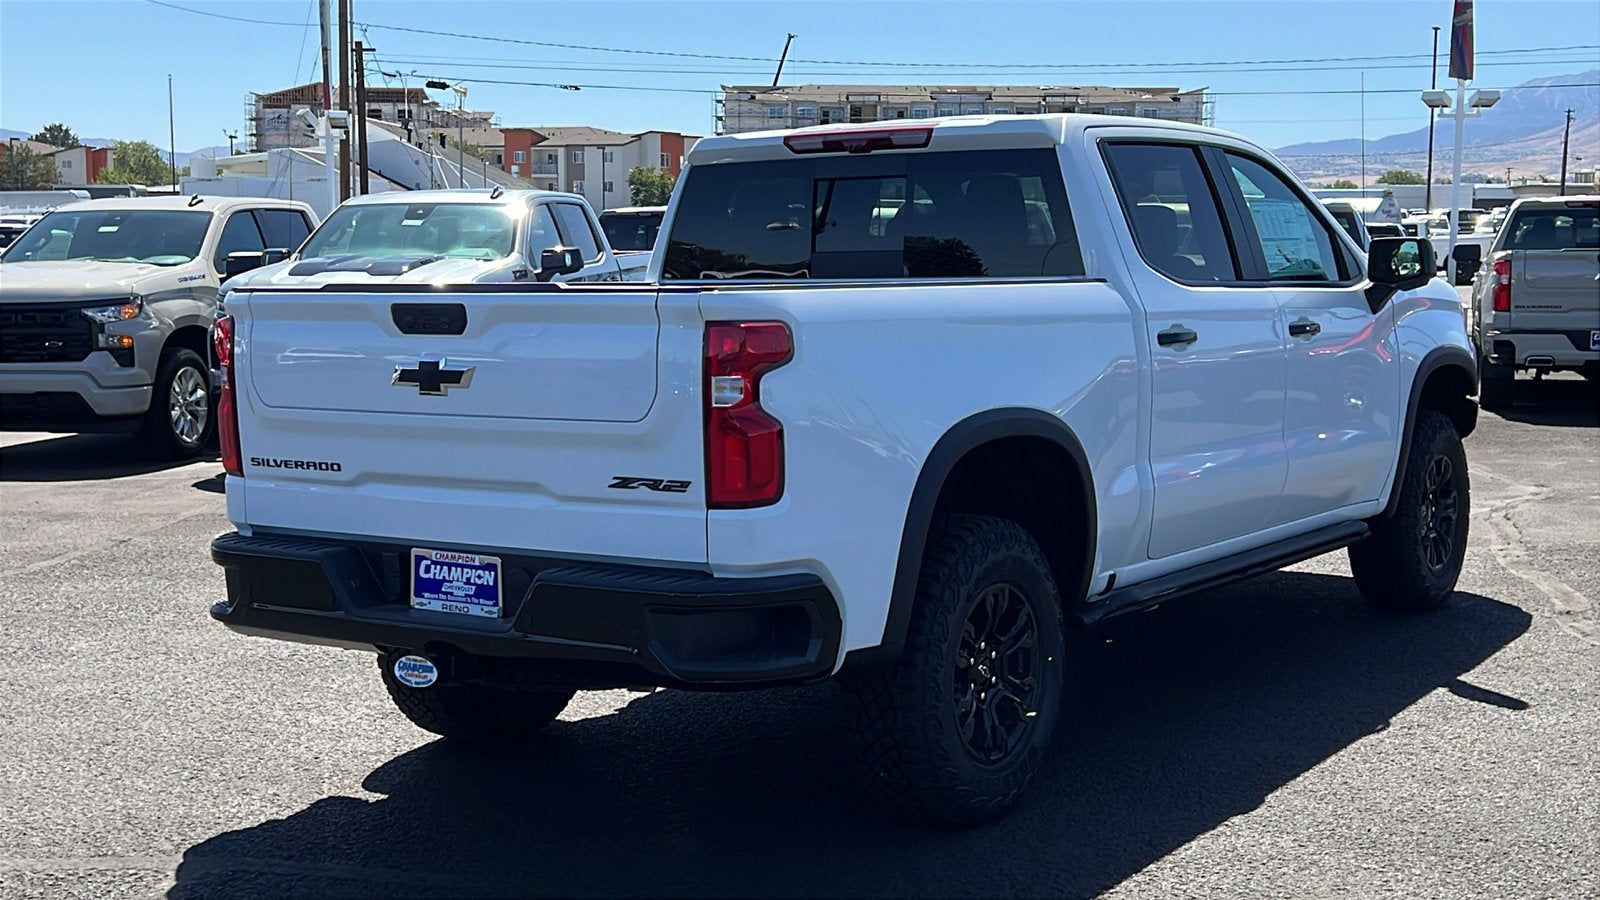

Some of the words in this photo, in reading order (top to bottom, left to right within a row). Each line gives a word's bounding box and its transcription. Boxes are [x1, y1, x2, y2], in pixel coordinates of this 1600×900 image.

[250, 457, 342, 472] SILVERADO
[607, 476, 693, 493] ZR2
[435, 552, 476, 564] CHAMPION
[419, 560, 495, 586] CHAMPION
[443, 584, 474, 593] CHEVROLET
[441, 603, 470, 613] RENO
